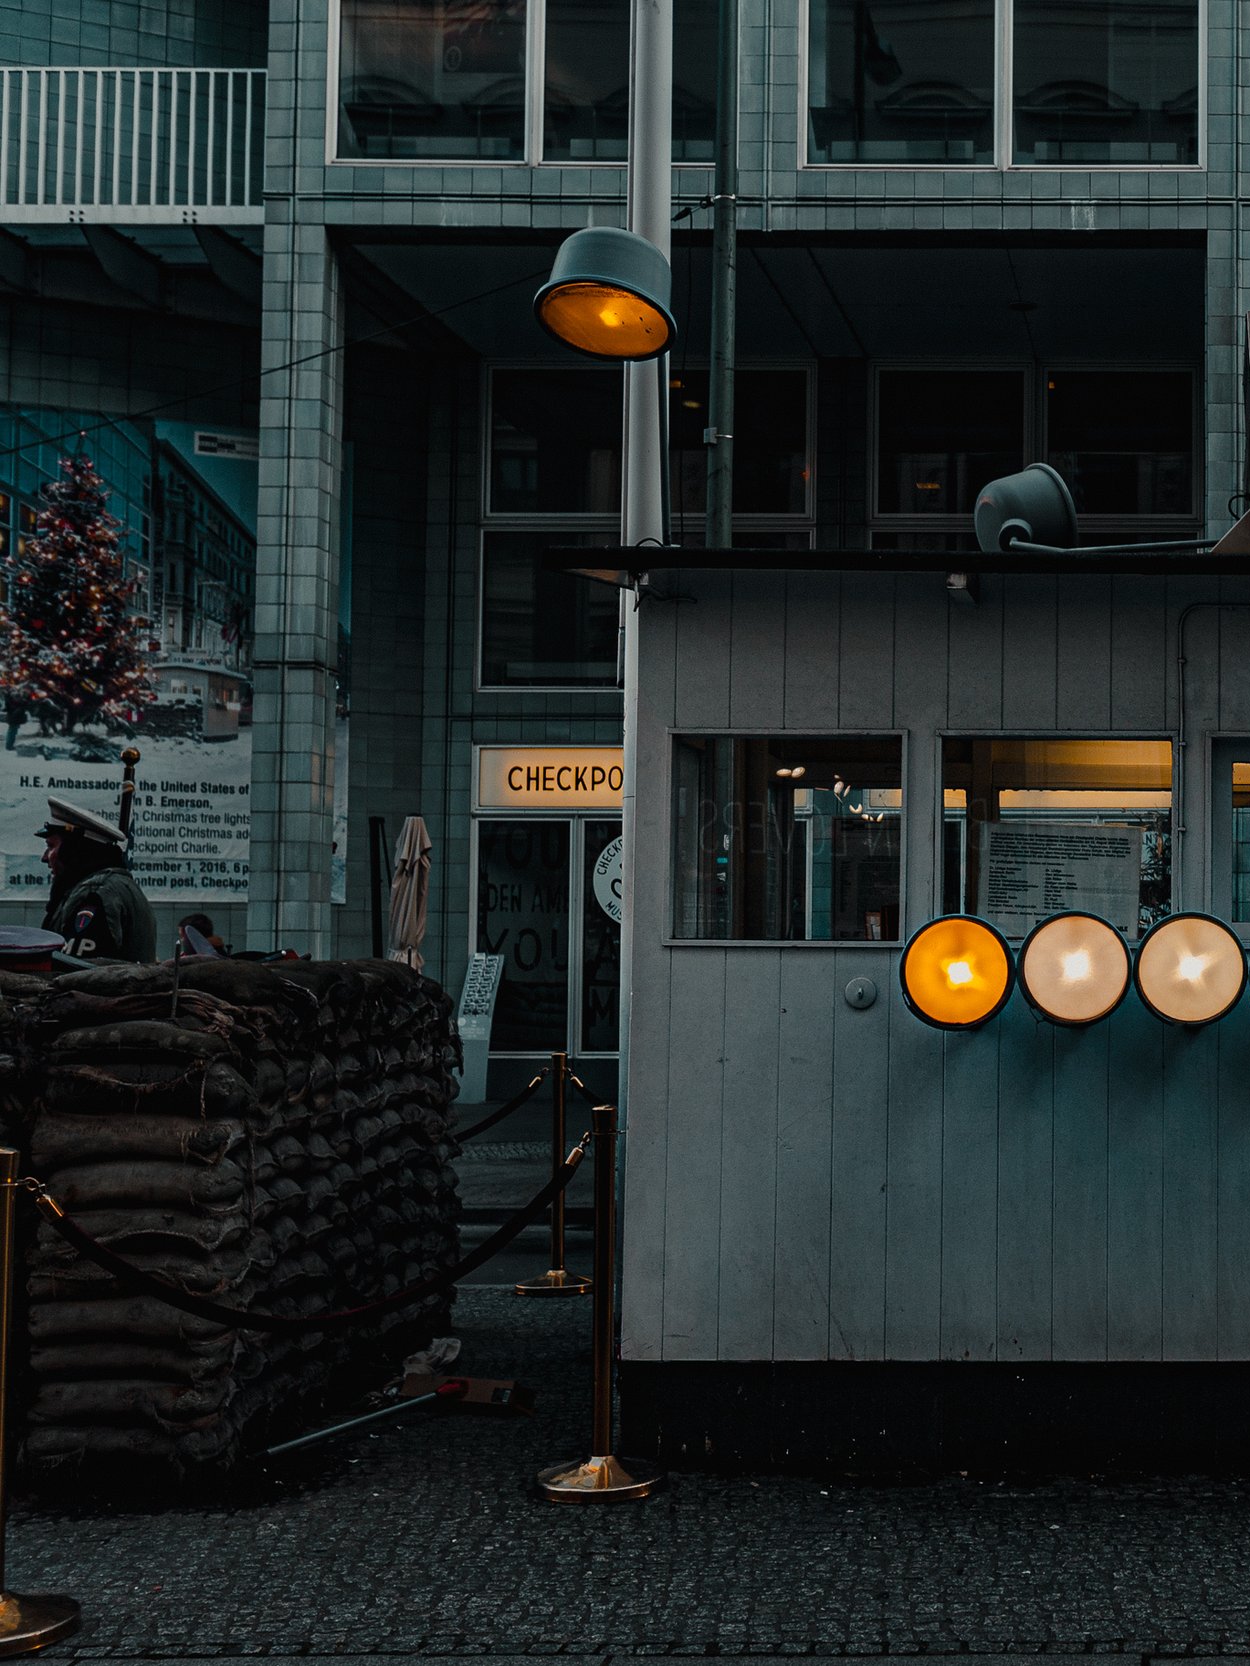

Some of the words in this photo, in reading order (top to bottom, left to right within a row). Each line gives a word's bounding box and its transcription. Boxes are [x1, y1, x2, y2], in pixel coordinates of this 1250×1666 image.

[508, 766, 623, 791] CHECKPO
[20, 776, 43, 787] H.E.
[47, 777, 121, 790] Ambassador
[139, 781, 157, 792] the
[161, 782, 196, 794] United
[200, 783, 234, 795] States
[238, 784, 249, 795] of
[145, 797, 157, 807] B.
[161, 797, 213, 810] Emerson,
[143, 812, 197, 824] Christmas
[201, 813, 222, 824] tree
[224, 813, 250, 826] lights
[180, 828, 233, 839] Christmas
[181, 842, 221, 854] Charlie.
[186, 862, 195, 874] 1,
[200, 862, 229, 875] 2016,
[9, 875, 21, 885] at
[24, 874, 43, 886] the
[170, 877, 197, 890] post,
